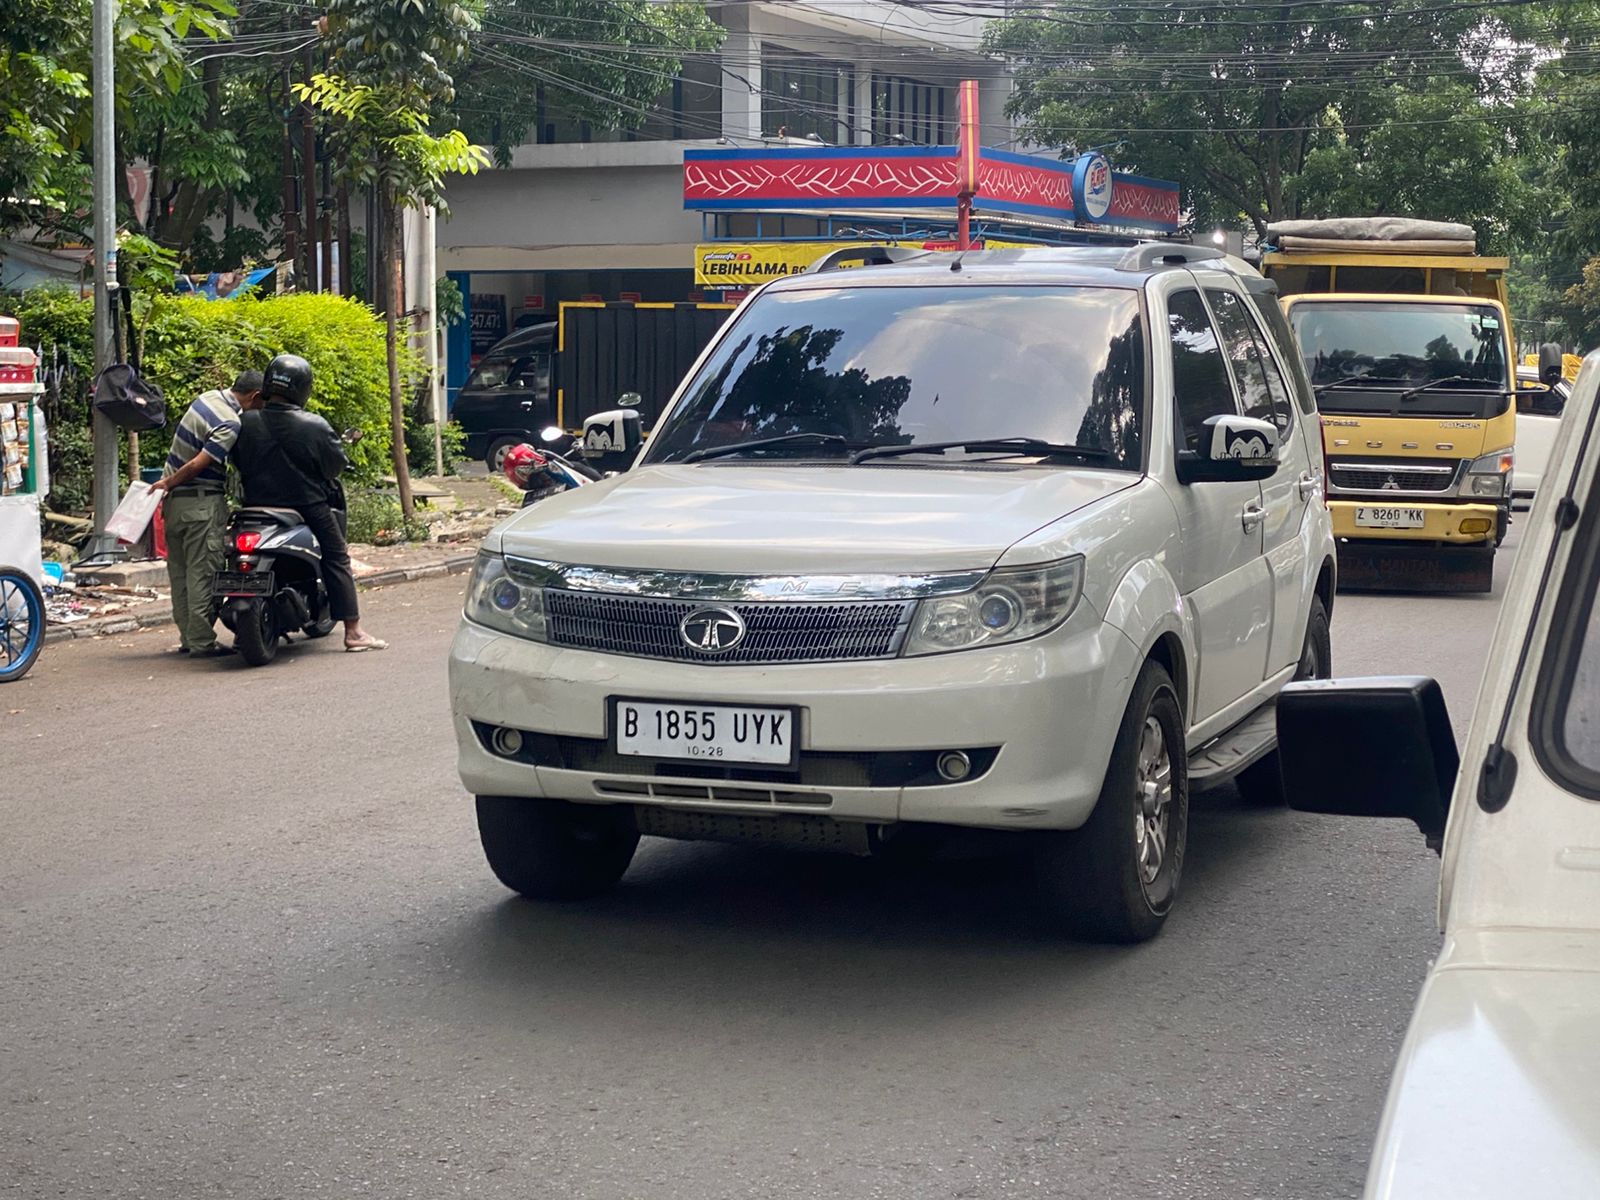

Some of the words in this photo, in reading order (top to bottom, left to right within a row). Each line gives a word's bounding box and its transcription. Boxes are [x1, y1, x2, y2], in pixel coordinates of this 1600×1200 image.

[702, 262, 743, 275] LEBIH
[745, 262, 788, 275] LAMA
[1334, 439, 1453, 450] FUSO
[1357, 508, 1365, 520] Z
[1373, 508, 1400, 520] 8260
[1409, 509, 1423, 521] KK
[624, 707, 639, 738] B
[655, 709, 716, 742] 1855
[733, 713, 785, 745] UYK
